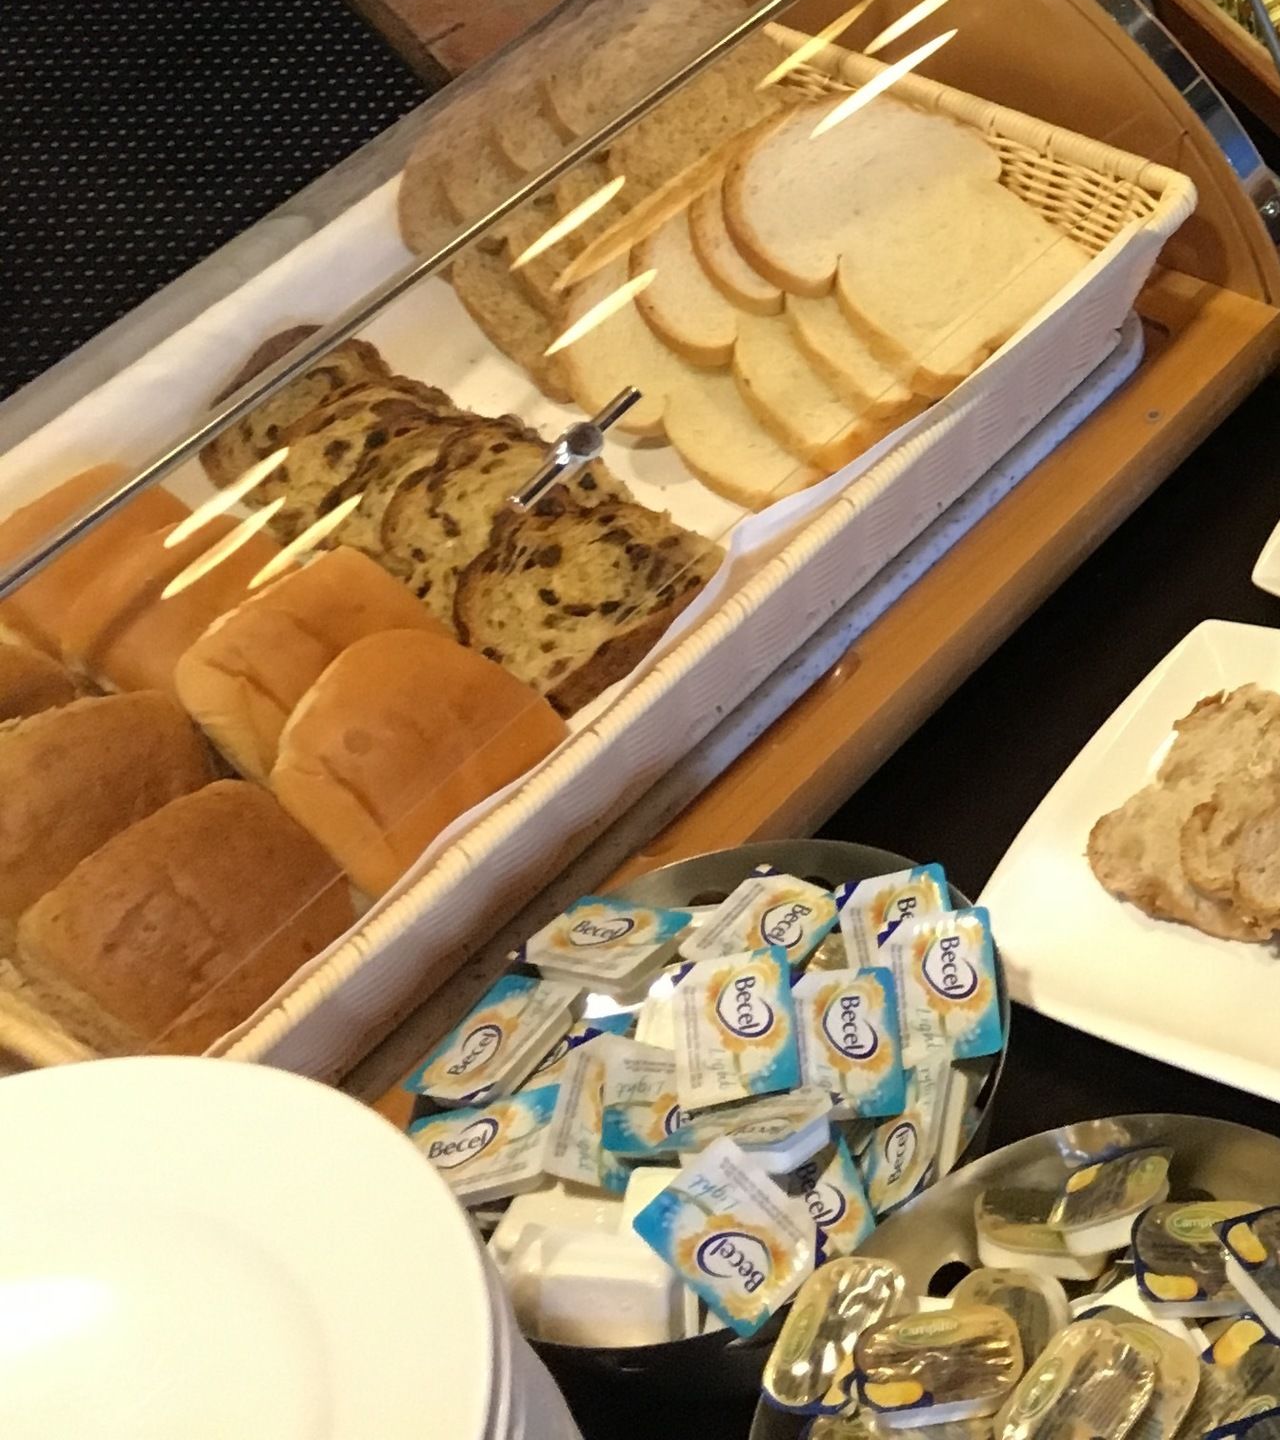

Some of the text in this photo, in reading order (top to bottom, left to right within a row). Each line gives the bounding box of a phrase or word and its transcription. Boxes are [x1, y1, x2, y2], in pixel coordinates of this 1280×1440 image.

[572, 919, 624, 940] Becel
[768, 903, 812, 944] Becel
[939, 935, 965, 994] Becel
[734, 975, 762, 1037] Becel
[840, 995, 866, 1052] Becel
[446, 1032, 498, 1076] Becel
[427, 1133, 489, 1160] Becel
[797, 1161, 833, 1222] Becel
[709, 1238, 766, 1294] Becel
